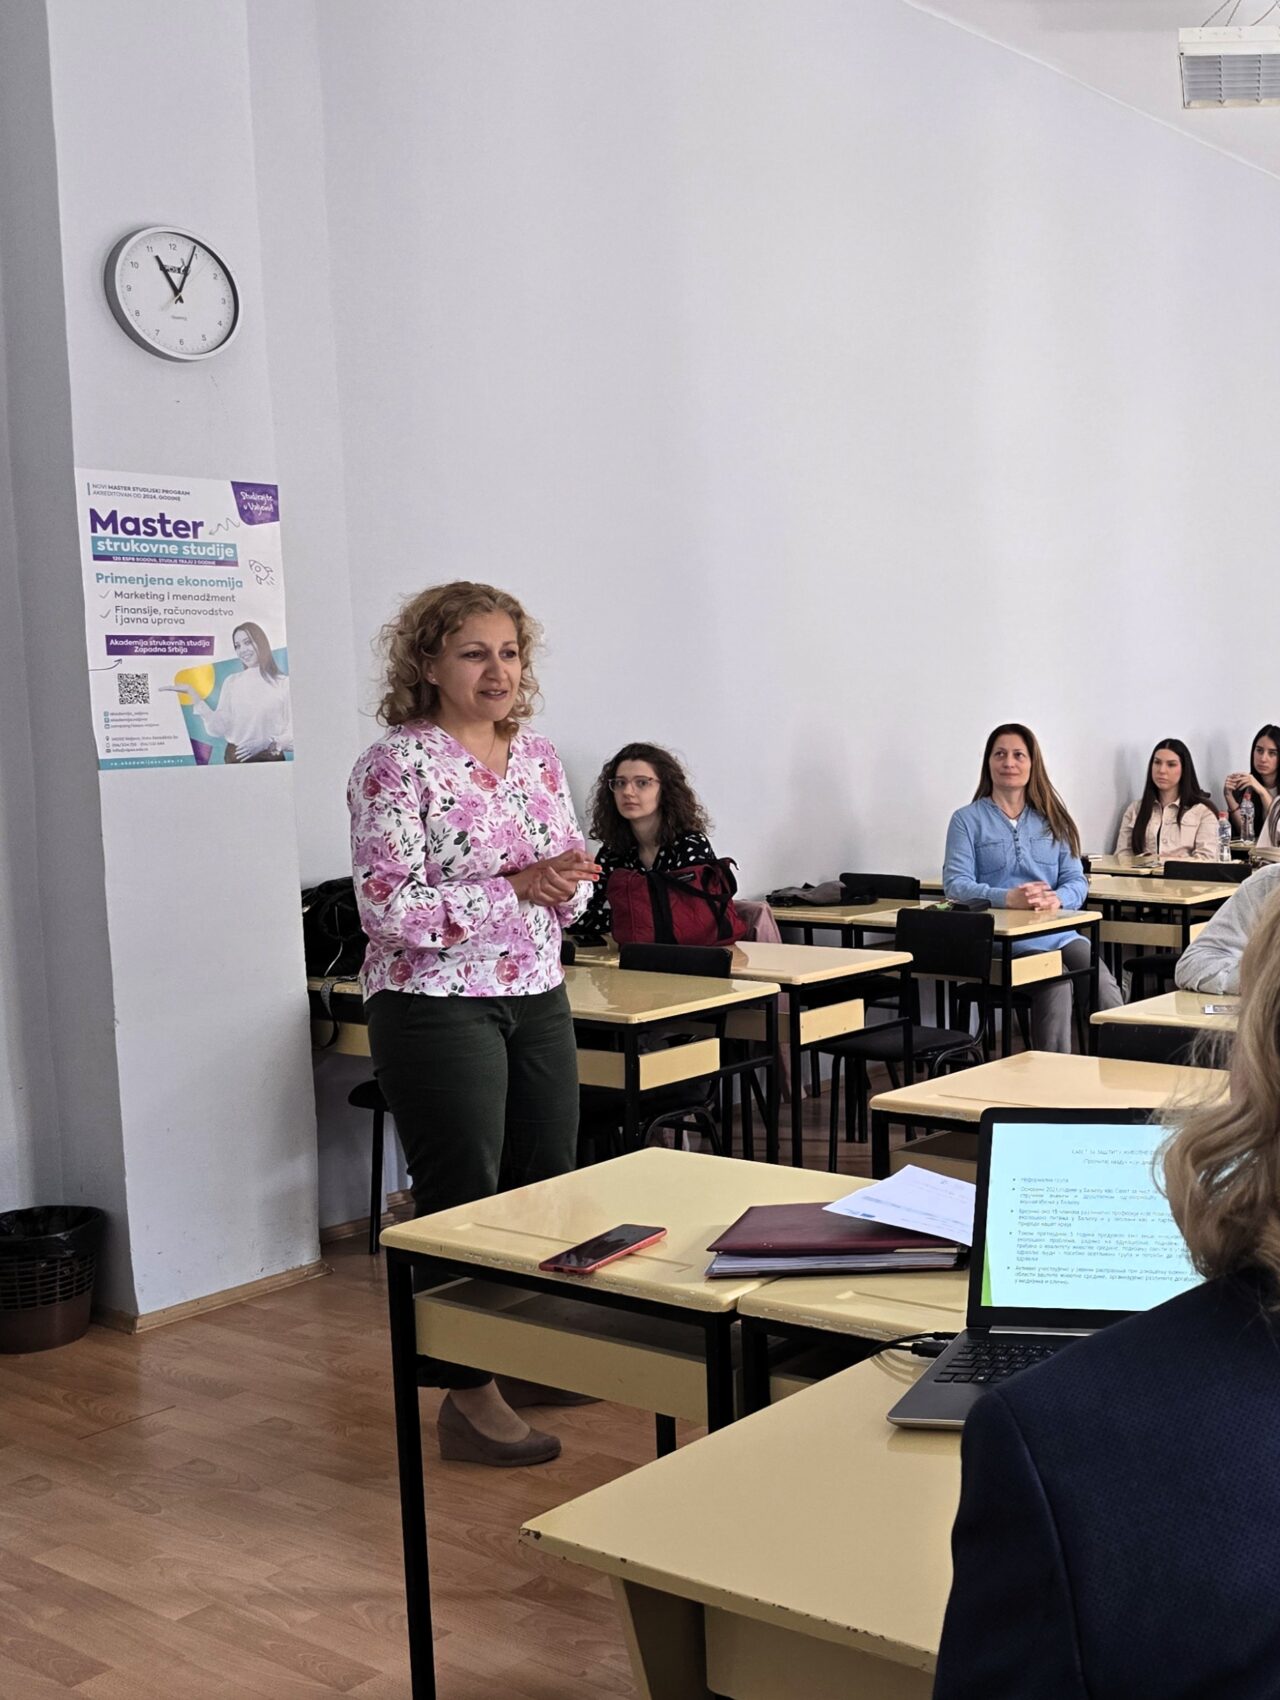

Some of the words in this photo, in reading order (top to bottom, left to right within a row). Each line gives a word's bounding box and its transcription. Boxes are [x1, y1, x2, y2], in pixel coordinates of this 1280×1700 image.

[169, 243, 177, 251] 12
[130, 261, 139, 269] 10
[126, 284, 132, 292] 9
[89, 507, 204, 539] Master
[97, 538, 180, 554] strukovne
[182, 543, 234, 559] studije
[95, 572, 174, 587] Primenjena
[177, 575, 243, 590] ekonomija
[114, 590, 165, 602] Marketing
[167, 591, 170, 600] i
[172, 592, 236, 602] menadžment
[115, 605, 162, 616] Finansije,
[163, 606, 234, 616] računovodstvo
[115, 615, 118, 624] i
[119, 615, 149, 626] javna
[151, 616, 185, 626] uprava
[109, 639, 148, 648] Akademija
[149, 639, 185, 647] strukovnih
[186, 640, 210, 648] studija
[134, 646, 166, 654] Zapadna
[167, 646, 188, 655] Srbija
